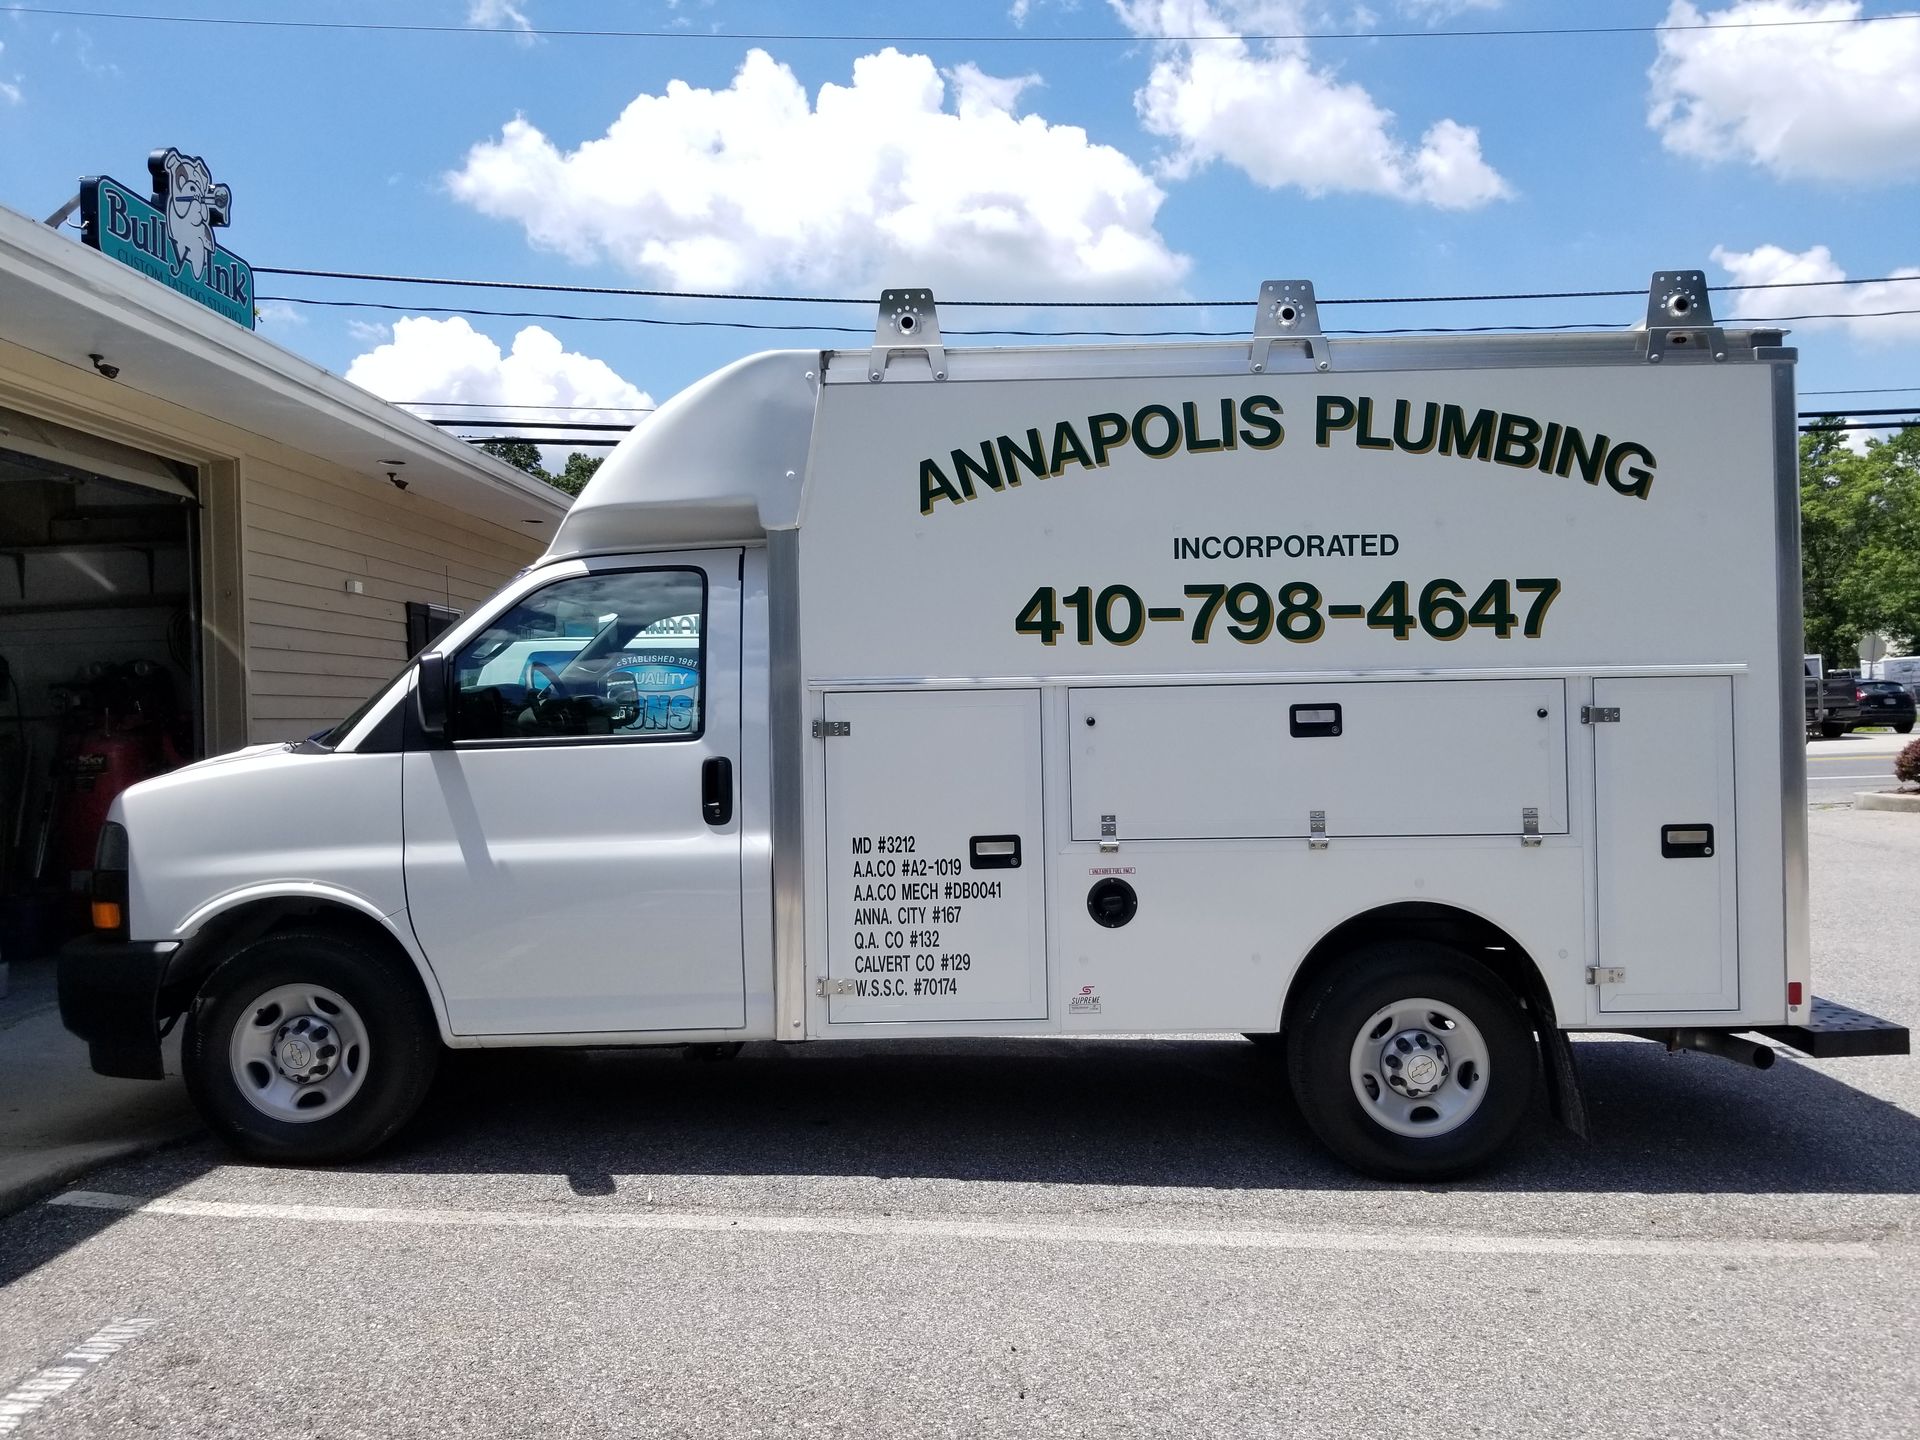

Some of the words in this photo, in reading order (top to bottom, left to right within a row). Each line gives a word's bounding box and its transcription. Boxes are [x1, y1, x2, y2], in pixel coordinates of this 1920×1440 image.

[104, 187, 190, 277] Bully
[204, 250, 249, 307] Ink
[117, 248, 164, 284] CUSTOM
[167, 273, 206, 304] TATTOO
[207, 296, 242, 325] STUDIO
[919, 395, 1285, 516] ANNAPOLIS
[1315, 395, 1658, 501] PLUMBING
[1173, 533, 1400, 560] INCORPORATED
[1015, 577, 1562, 647] 410-798-4647
[678, 657, 698, 668] 1981
[634, 672, 689, 686] UALITY
[852, 836, 872, 855] MD
[878, 835, 916, 854] #3212
[853, 860, 896, 878] A.A.CO
[901, 858, 962, 876] #A2-1019
[853, 883, 897, 902] A.A.CO
[901, 882, 939, 901] MECH
[944, 881, 1002, 900] #DB0041
[854, 907, 893, 926] ANNA.
[897, 906, 927, 925] CITY
[932, 905, 962, 924] #167
[854, 931, 880, 950] Q.A.
[884, 930, 904, 949] CO
[909, 930, 940, 948] #132
[854, 954, 911, 974] CALVERT
[915, 953, 935, 972] CO
[940, 953, 971, 971] #129
[855, 978, 908, 997] W.S.S.C.
[913, 977, 958, 996] #70174
[1071, 996, 1101, 1005] SUPREME
